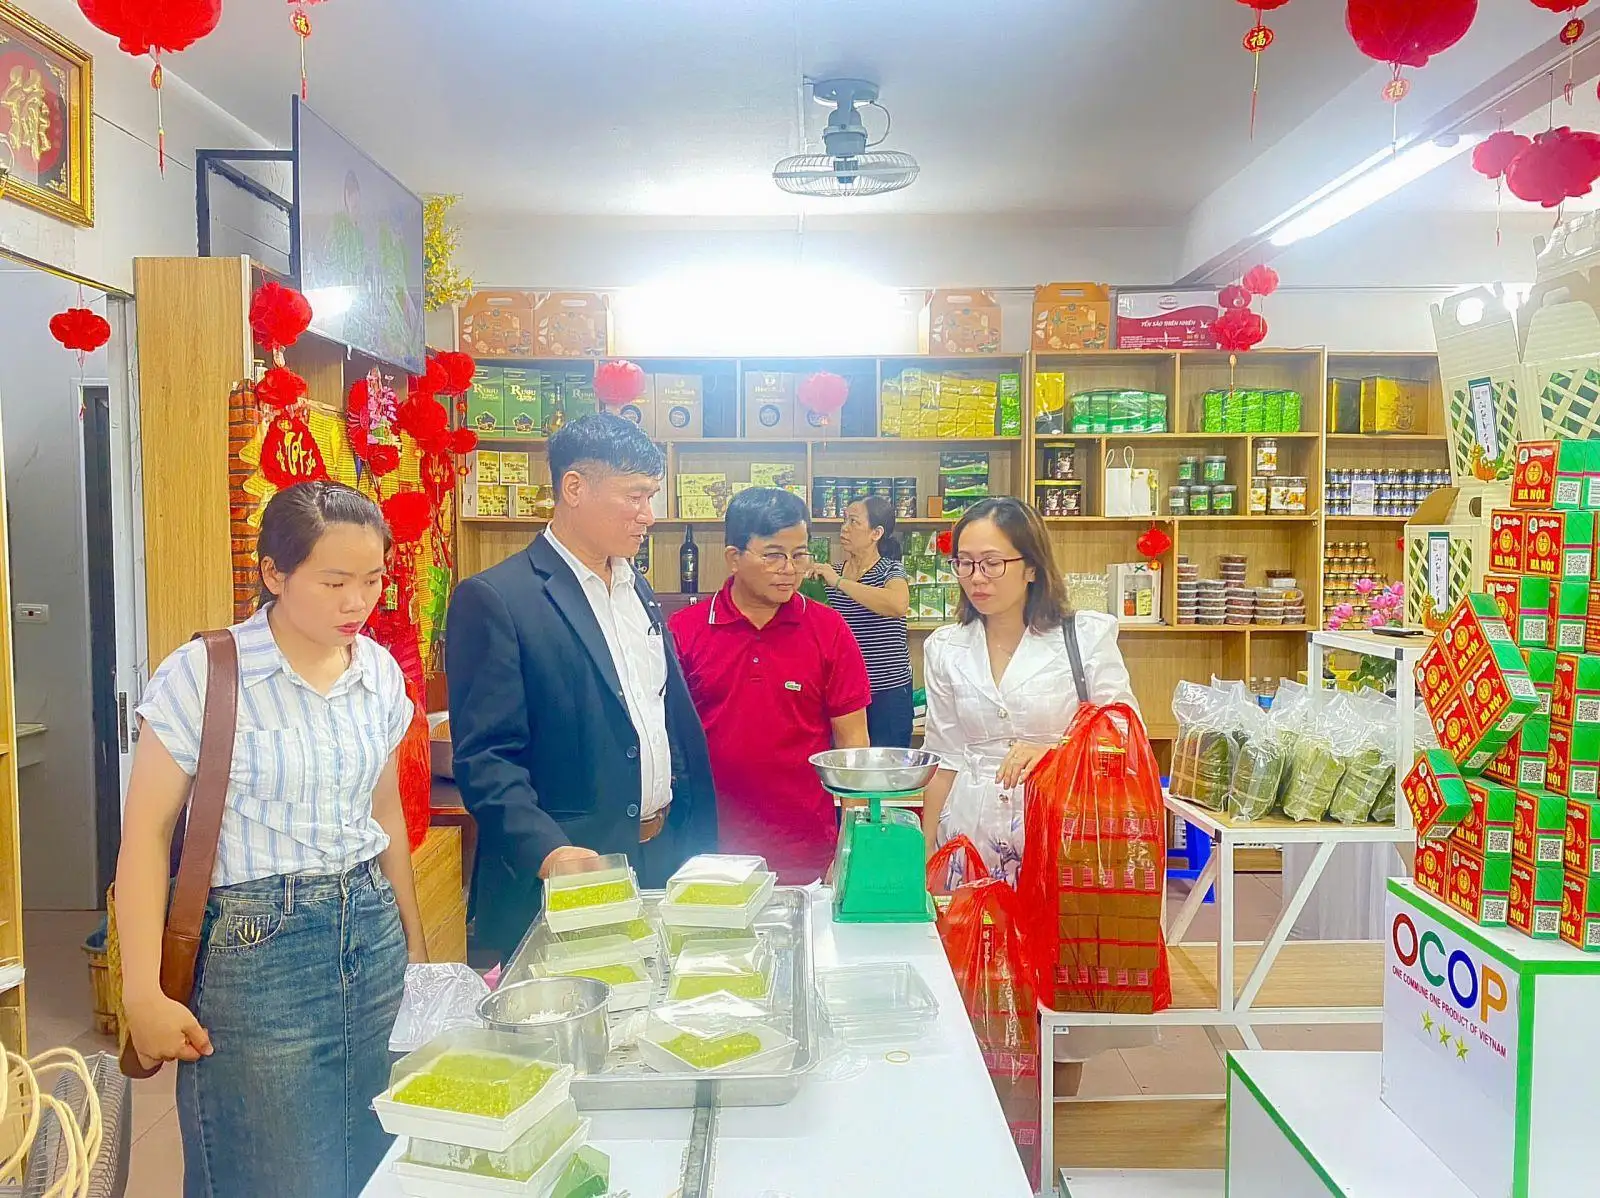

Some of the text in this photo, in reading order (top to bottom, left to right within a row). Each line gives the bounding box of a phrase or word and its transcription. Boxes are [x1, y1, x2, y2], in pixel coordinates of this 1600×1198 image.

[1518, 486, 1545, 502] HÀ NỘI
[1392, 965, 1507, 1058] ONE COMMUNE ONE PRODUCT OF VIETNAM
[1393, 913, 1508, 1024] OCOP
